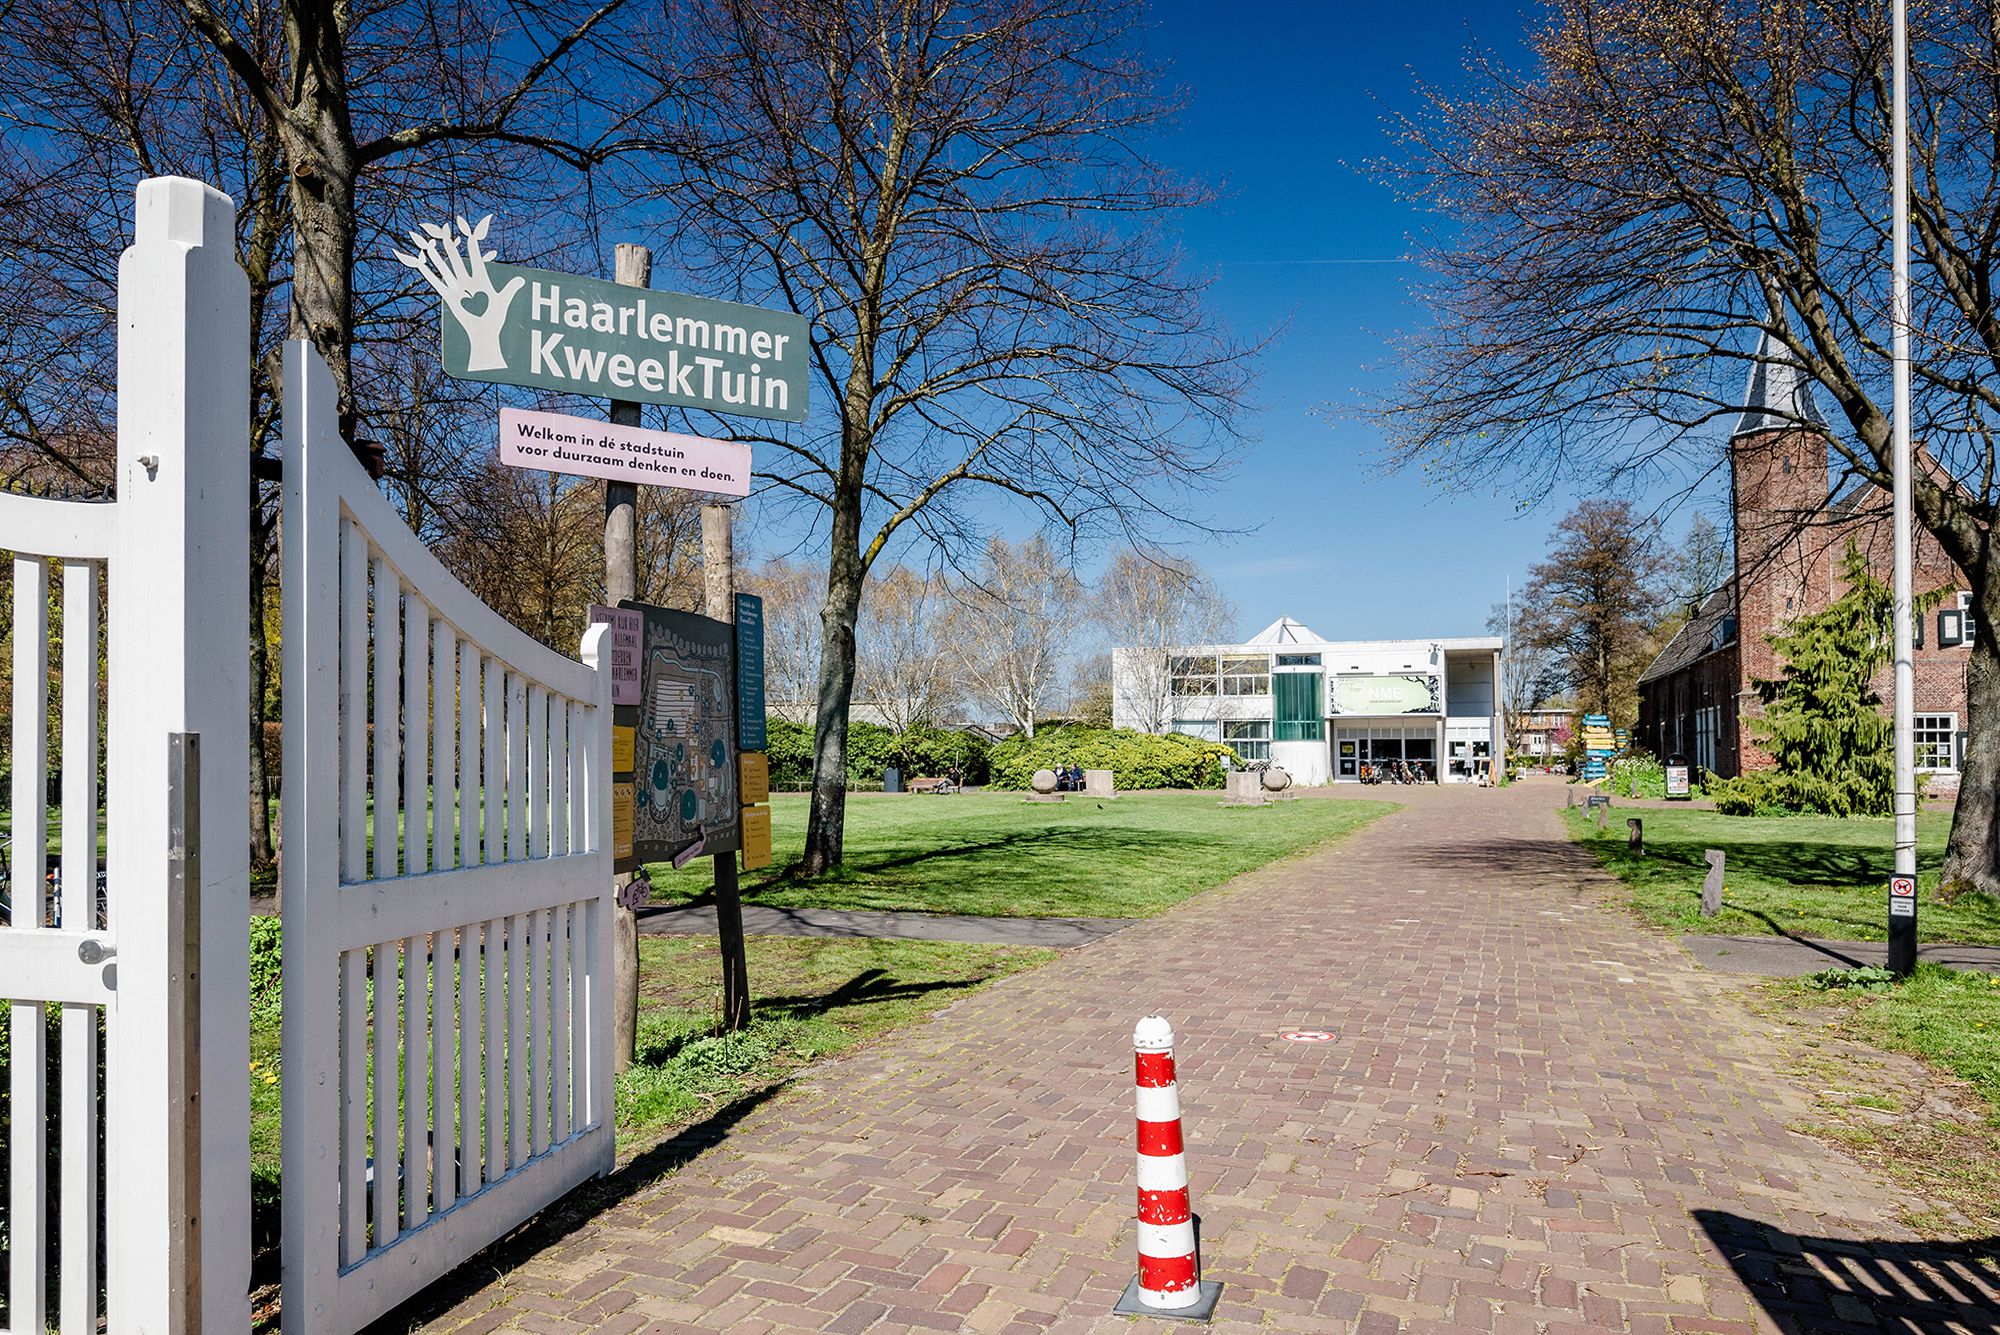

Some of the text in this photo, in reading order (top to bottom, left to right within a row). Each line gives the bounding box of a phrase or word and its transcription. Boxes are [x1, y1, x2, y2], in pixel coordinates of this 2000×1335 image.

[531, 281, 790, 362] Haarlemmer
[531, 329, 788, 411] KweekTuin
[516, 445, 735, 482] voor duurzaam denken en doen.
[517, 422, 685, 459] Welkom in dé stadstuin
